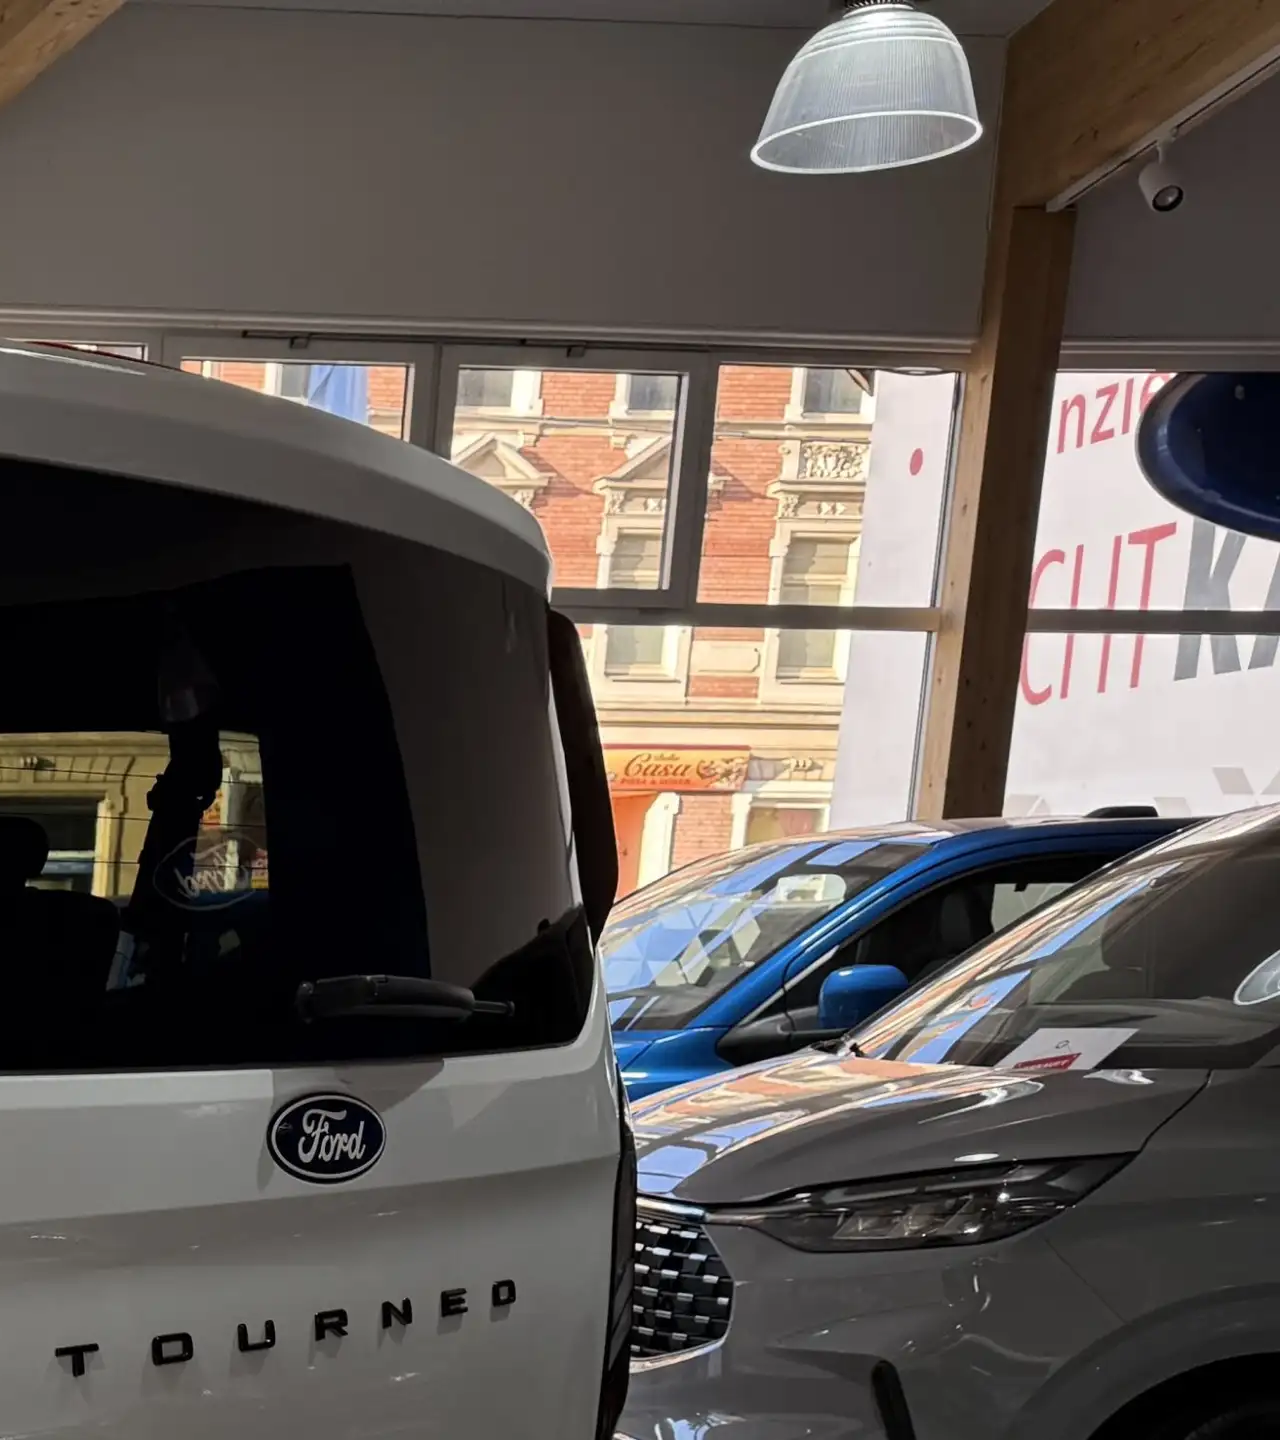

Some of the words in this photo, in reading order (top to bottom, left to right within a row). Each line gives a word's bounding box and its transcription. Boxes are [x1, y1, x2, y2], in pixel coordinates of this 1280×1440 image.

[624, 753, 692, 776] Casa
[298, 1108, 366, 1163] Ford
[55, 1279, 516, 1377] TOURNEO
